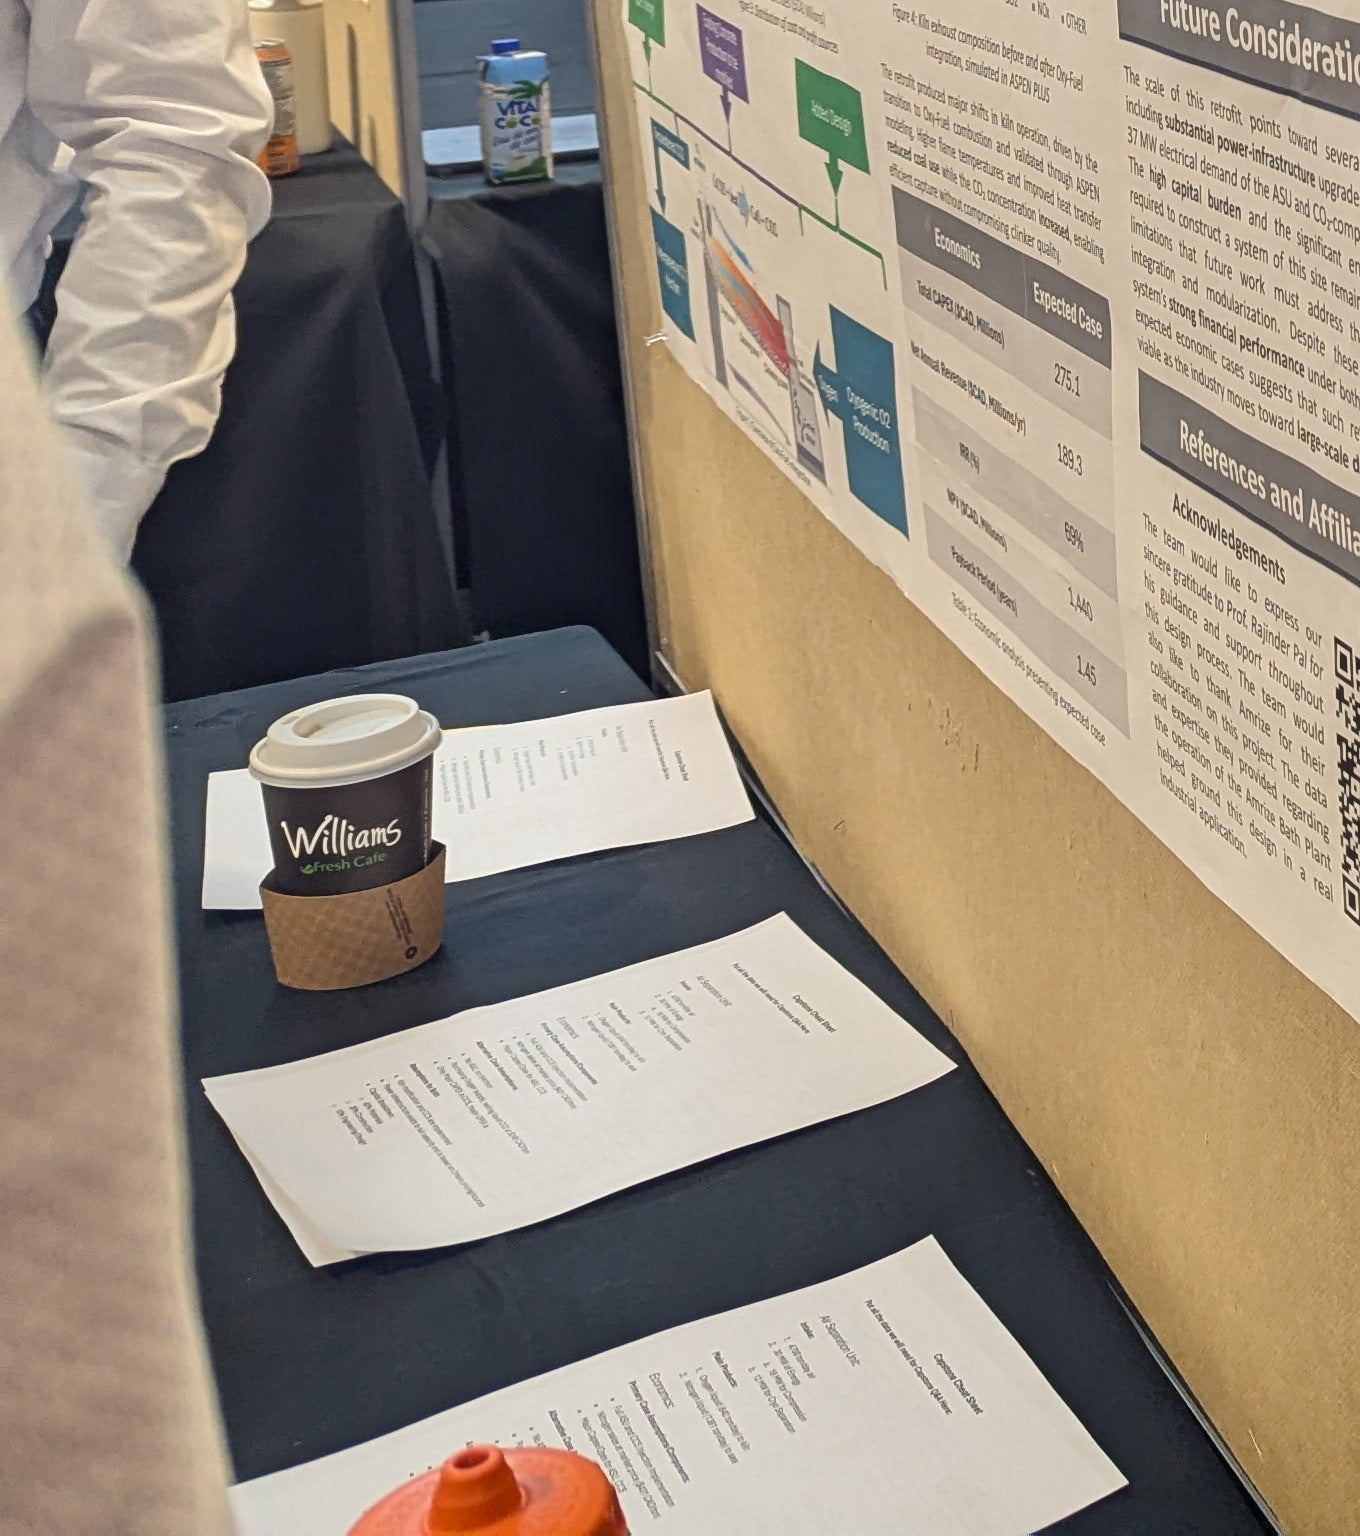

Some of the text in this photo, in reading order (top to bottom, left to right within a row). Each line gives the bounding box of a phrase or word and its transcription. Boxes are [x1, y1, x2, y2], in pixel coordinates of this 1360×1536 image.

[496, 100, 536, 115] VITA
[934, 227, 981, 269] Economics
[1033, 282, 1102, 339] Expected Case
[1055, 363, 1080, 396] 275.1
[1057, 443, 1083, 477] 189.3
[1180, 419, 1266, 496] References
[1270, 482, 1303, 522] and
[1064, 521, 1084, 553] 69%
[1173, 494, 1285, 585] Acknowledgements
[1068, 586, 1093, 623] 1,440
[1077, 655, 1096, 685] 1.45
[281, 815, 401, 858] Williams
[314, 859, 350, 872] Fresh
